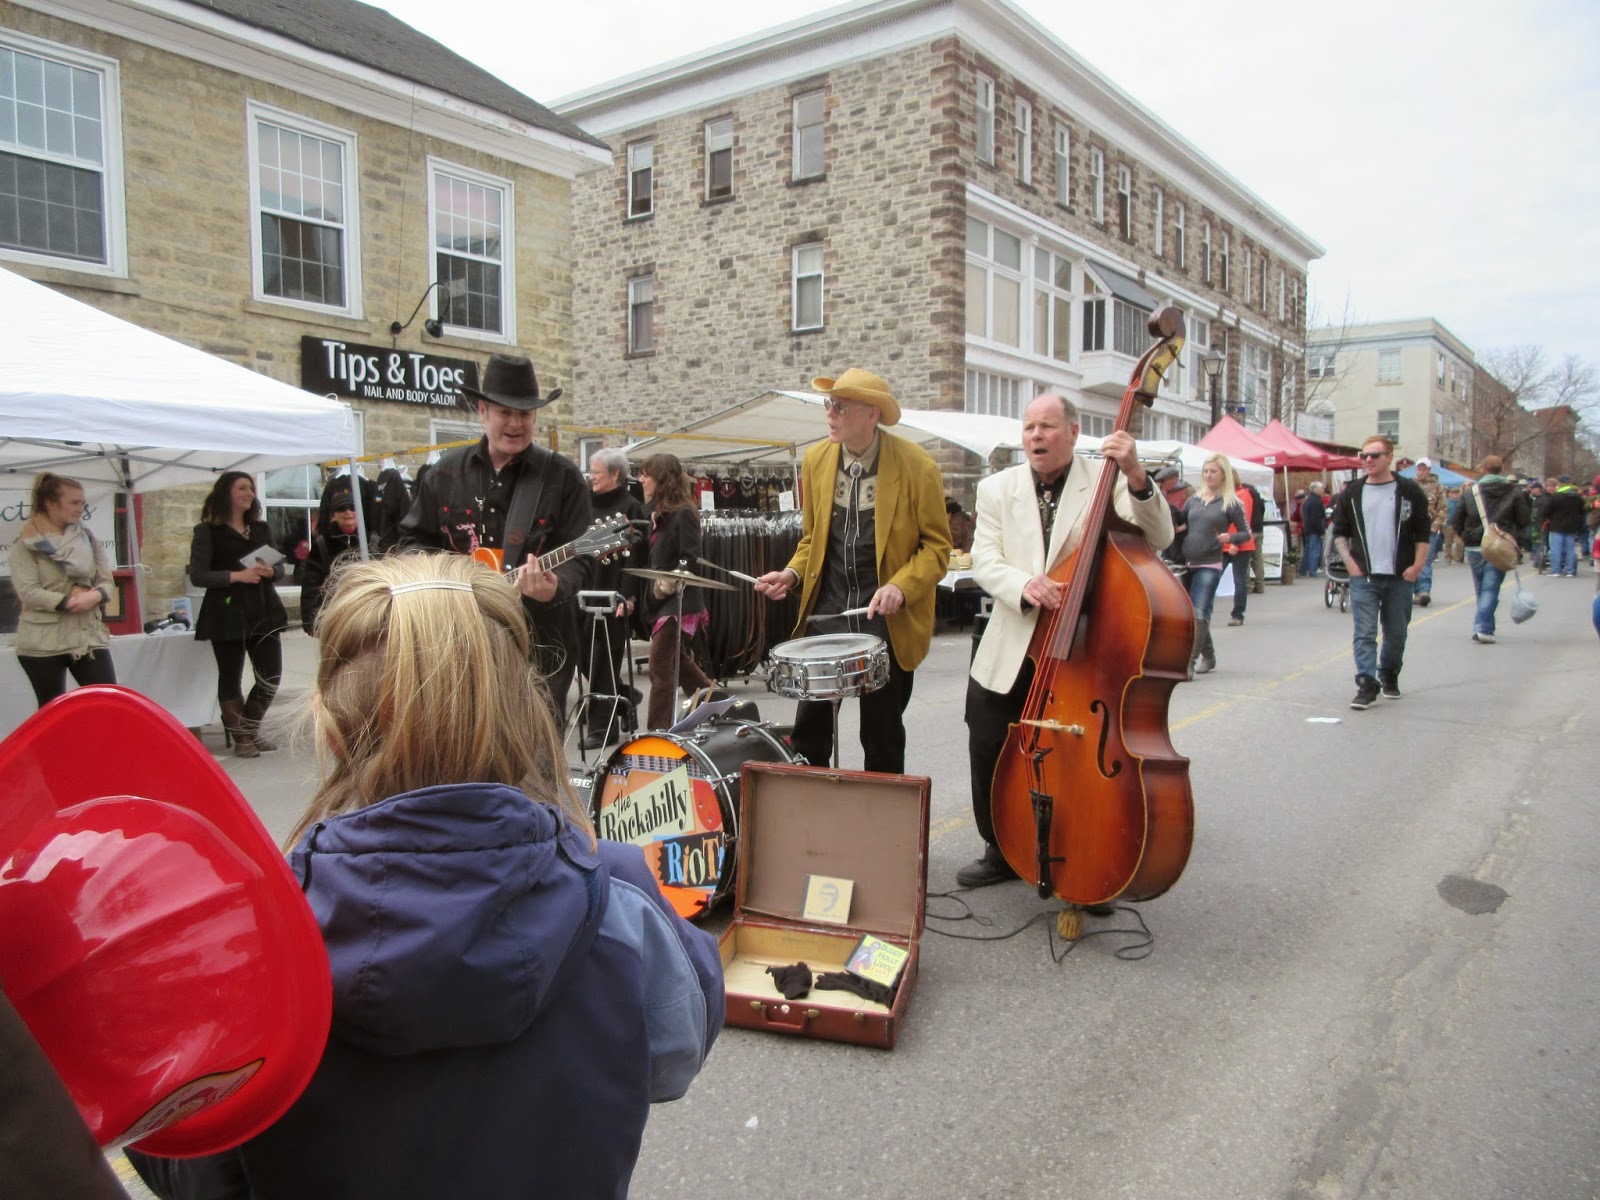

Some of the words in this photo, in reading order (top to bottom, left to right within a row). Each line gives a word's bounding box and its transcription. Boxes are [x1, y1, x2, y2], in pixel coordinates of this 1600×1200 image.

[322, 340, 380, 391] Tips
[387, 353, 405, 385] &
[409, 353, 465, 394] Toes
[364, 385, 384, 399] NAIL
[386, 387, 405, 401] AND
[406, 389, 429, 404] BODY
[430, 392, 456, 407] SALON
[602, 779, 688, 844] Rockabilly
[613, 789, 632, 820] The
